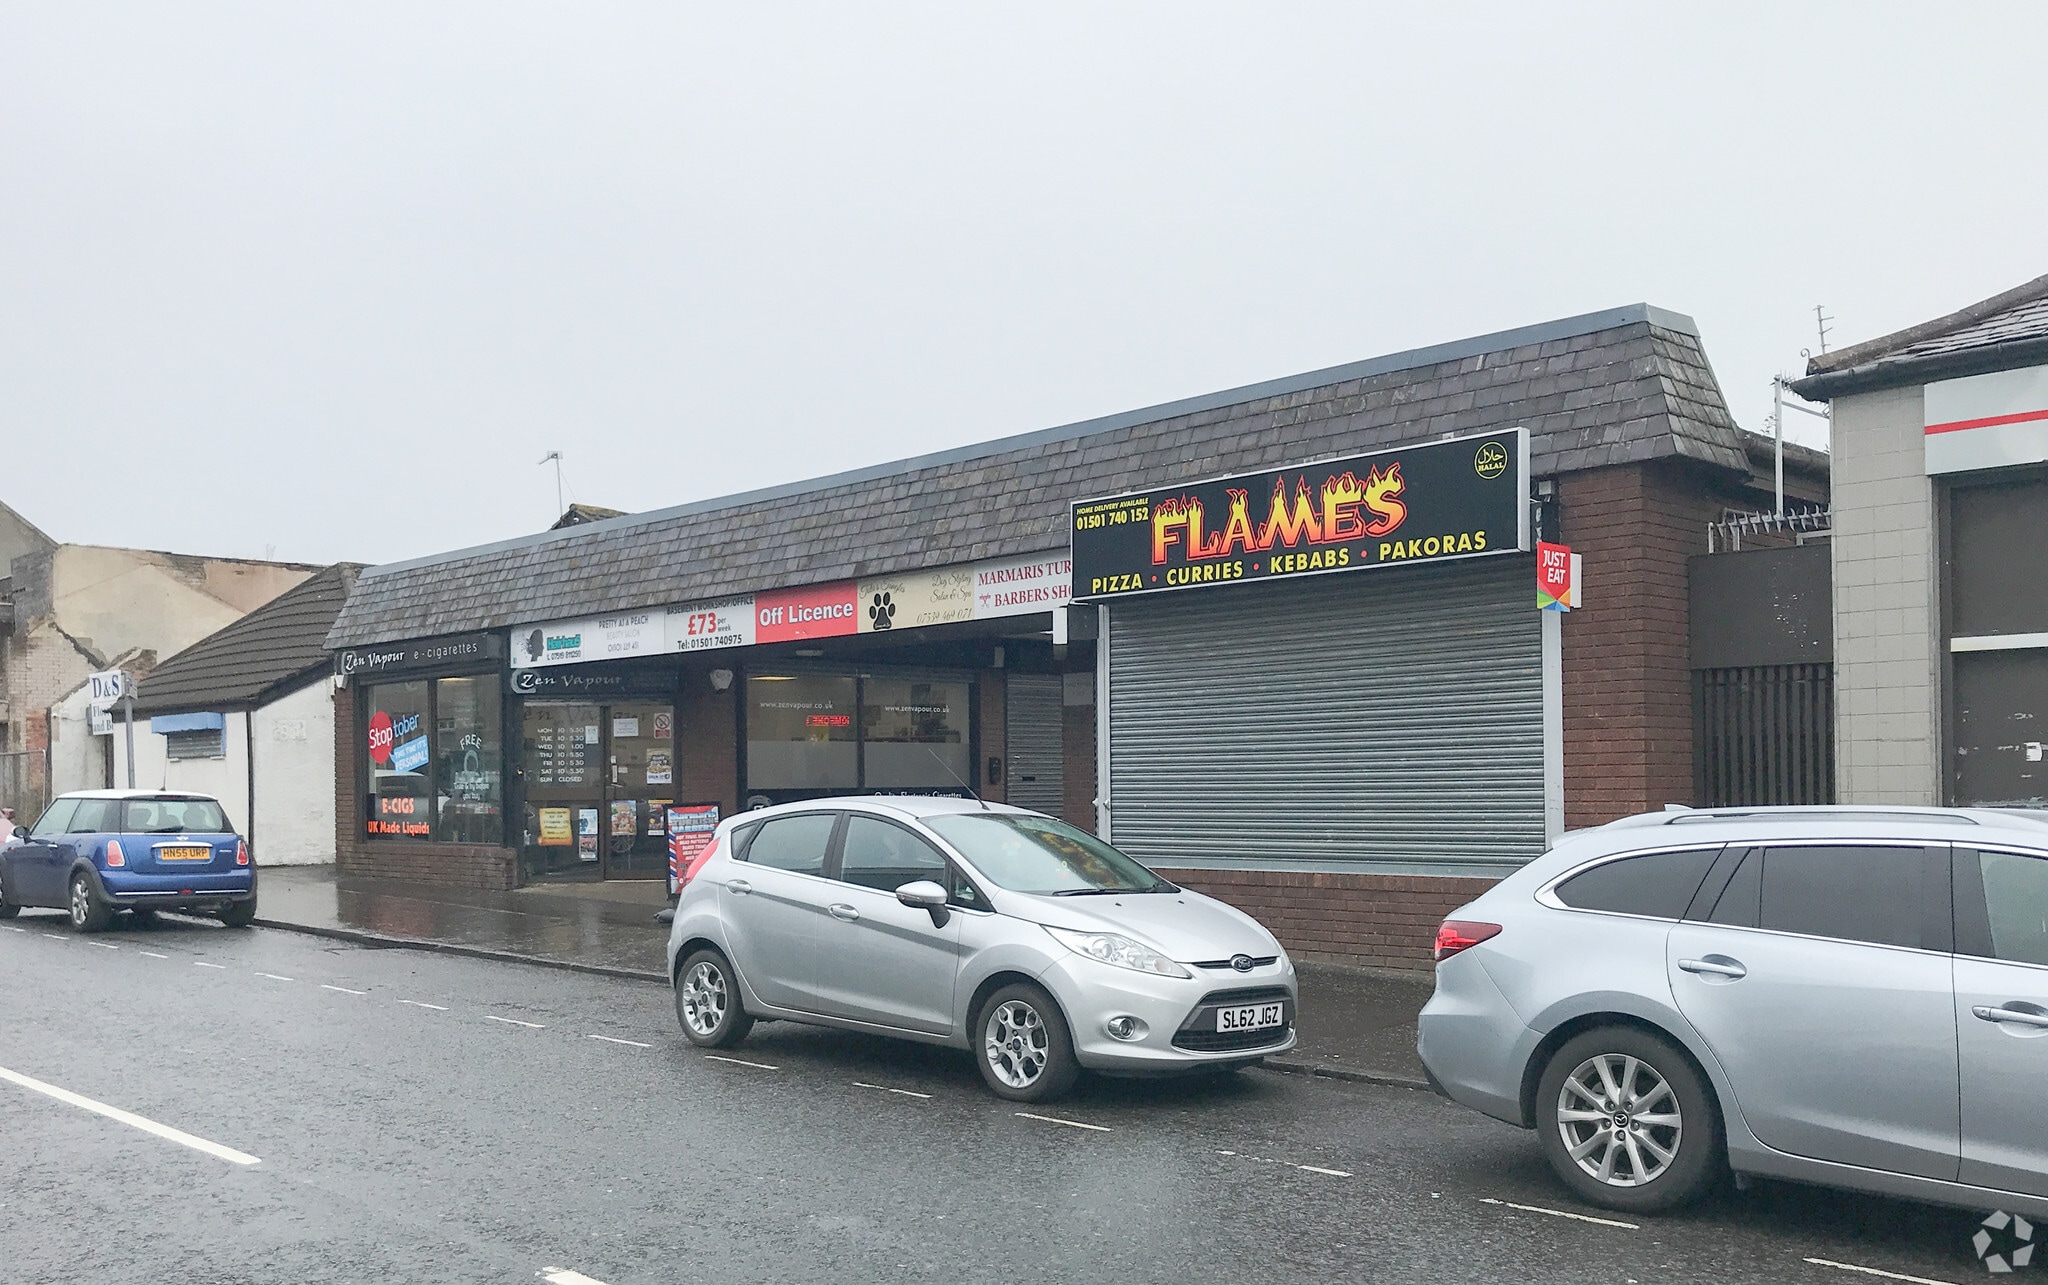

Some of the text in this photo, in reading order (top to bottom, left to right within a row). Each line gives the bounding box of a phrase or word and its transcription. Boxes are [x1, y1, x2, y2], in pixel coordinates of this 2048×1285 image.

[1478, 461, 1504, 472] HALAL
[1076, 497, 1149, 515] HOME DELIVERY AVAILABLE
[1152, 461, 1407, 565] FLAMES
[1076, 507, 1149, 530] 01501 740 152
[1092, 530, 1487, 594] PIZZA CURRIES KEBABS PAKORAS
[1542, 549, 1566, 568] JUST
[978, 559, 1071, 586] MARMARIS TUR
[1547, 567, 1566, 585] EAT
[666, 595, 754, 615] BASEMENT WORKSHOP/OFFICE
[994, 587, 1049, 607] BARBERS
[598, 619, 617, 629] PRETTY
[630, 615, 649, 626] PEACH
[717, 618, 727, 626] per
[759, 602, 854, 627] Off Licence
[687, 612, 717, 636] £73
[717, 624, 732, 633] week
[677, 634, 743, 650] Tel: 01501 740975
[345, 652, 366, 671] Zen
[367, 650, 405, 670] Vapour
[521, 674, 623, 690] Zen Vapour
[460, 733, 482, 751] FREE
[381, 797, 415, 814] E-CIGS
[367, 820, 430, 837] UK Made Liquids
[162, 848, 208, 858] HN55 URP
[1223, 1005, 1279, 1029] SL62 JGZ
